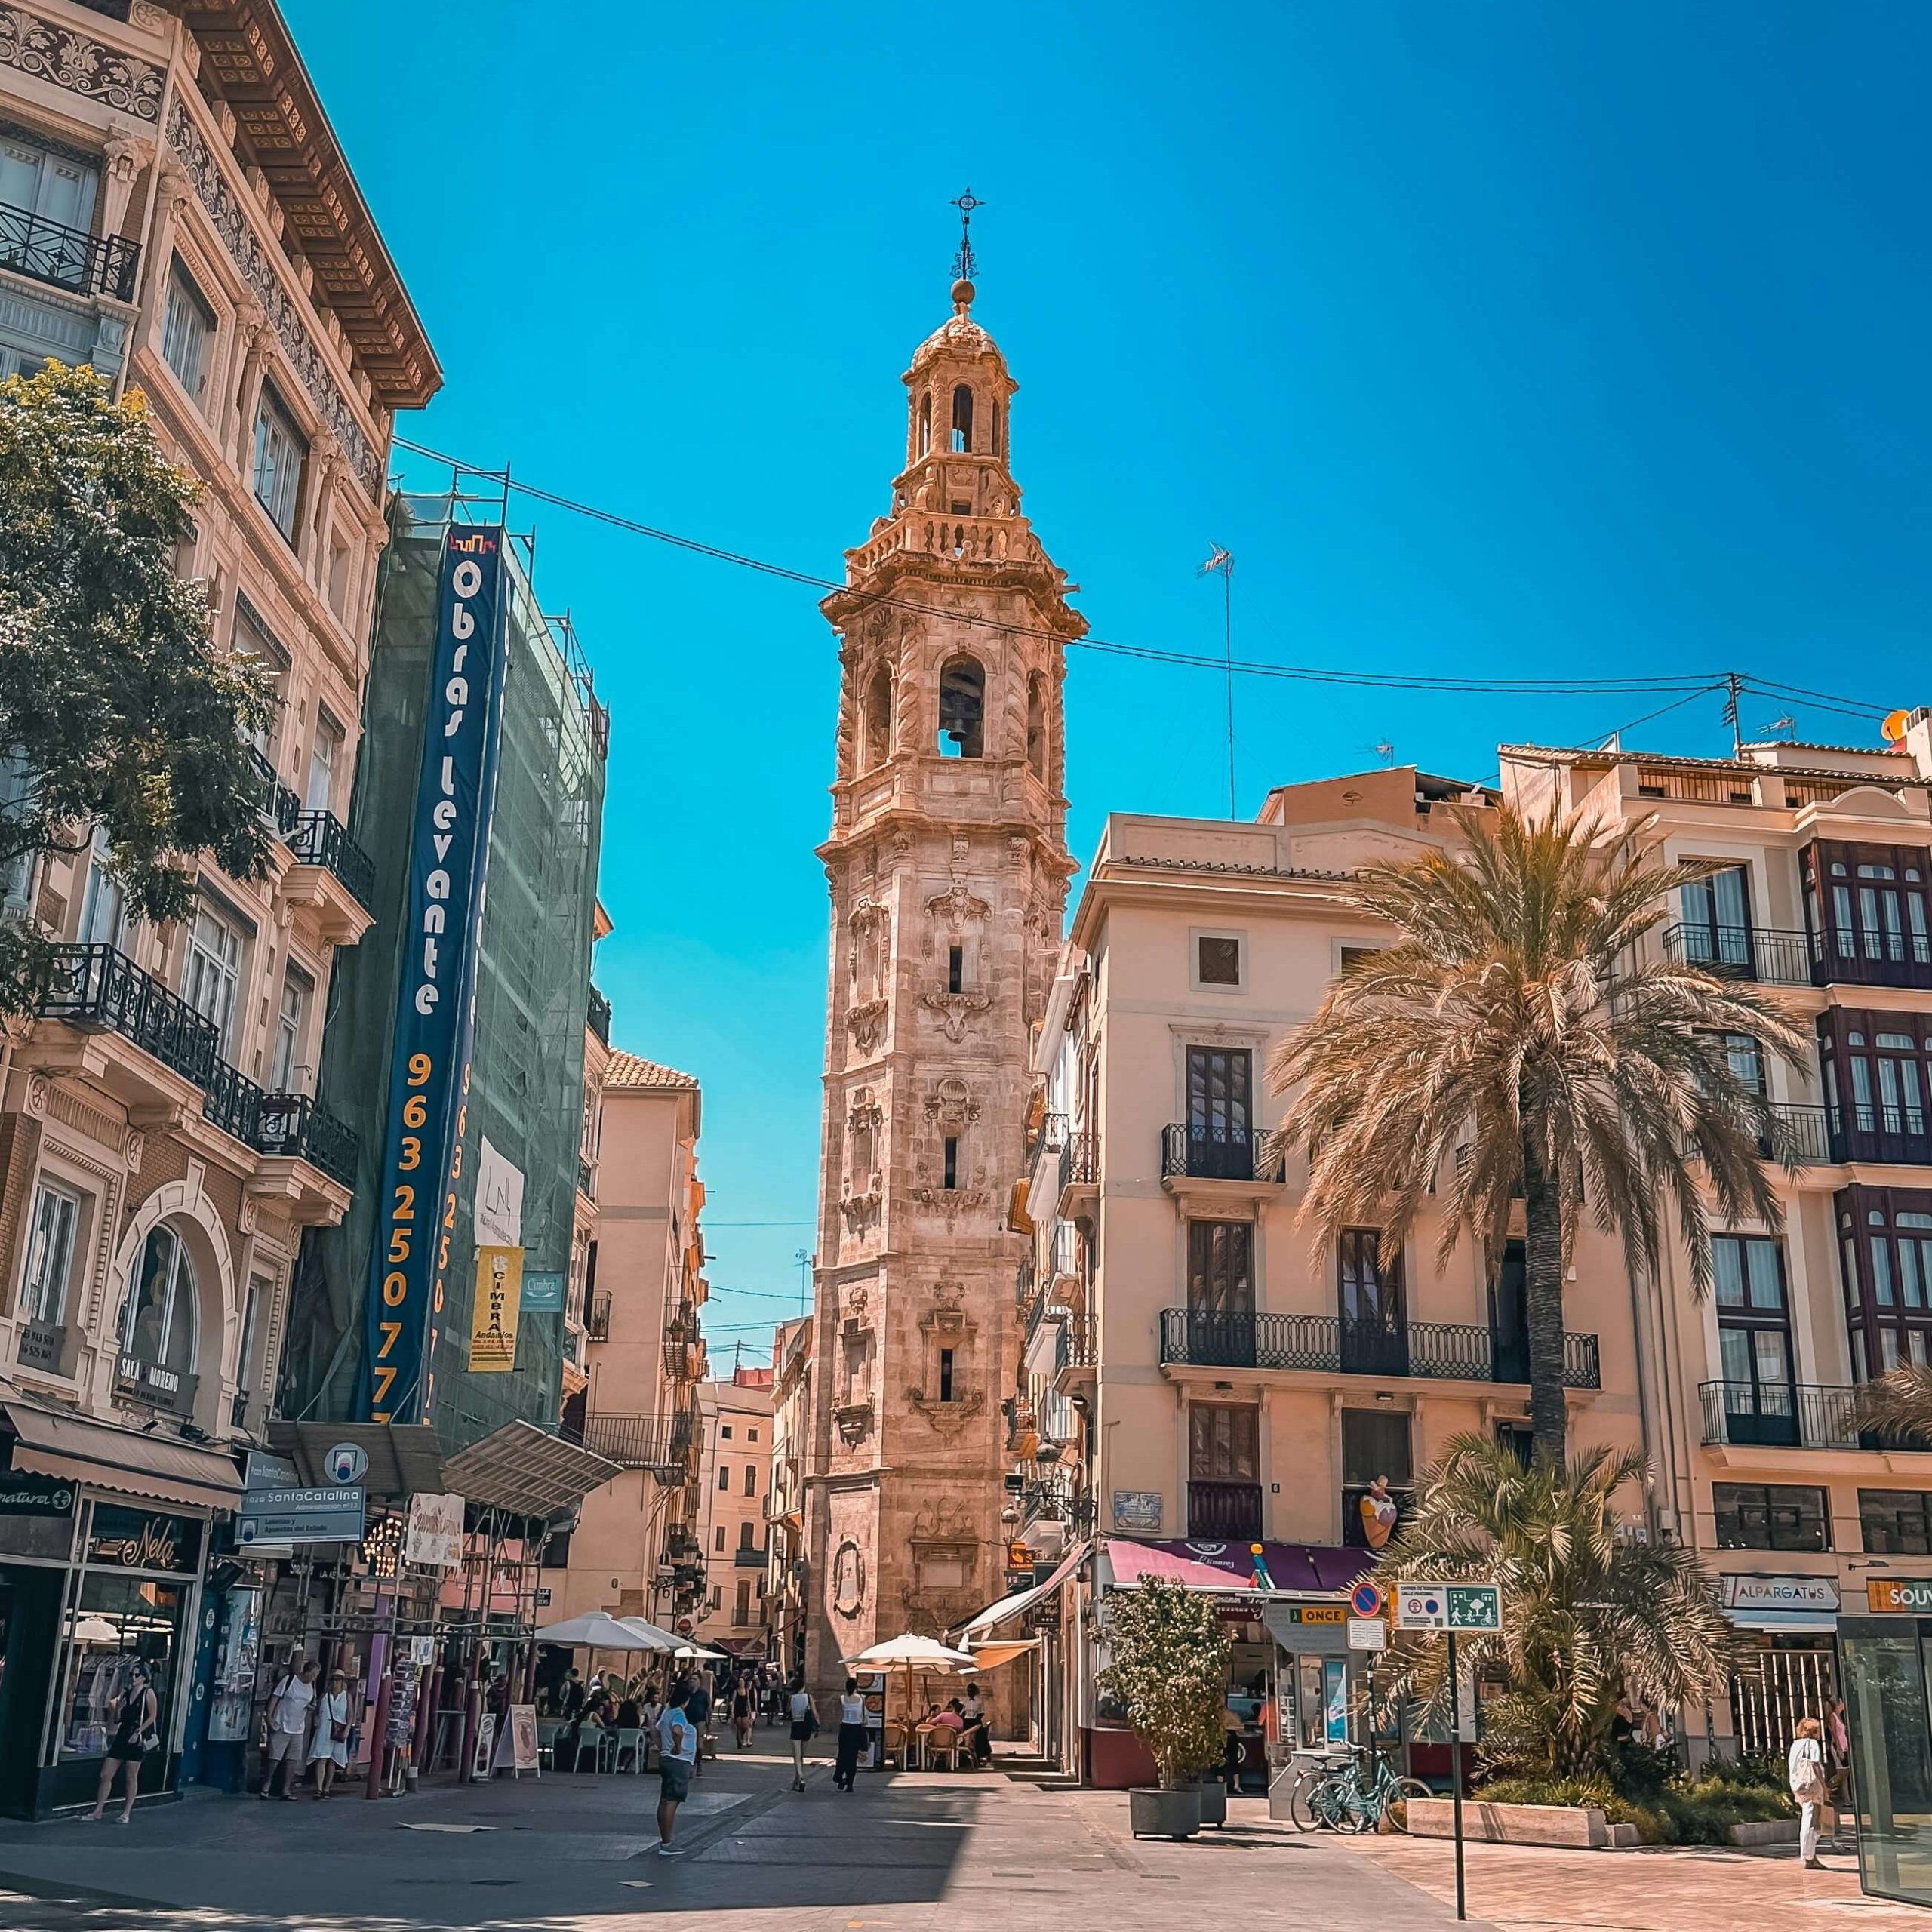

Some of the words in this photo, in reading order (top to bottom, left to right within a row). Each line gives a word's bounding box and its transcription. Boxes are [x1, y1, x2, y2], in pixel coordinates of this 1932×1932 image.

[444, 559, 481, 737] Obras
[415, 755, 457, 1015] levante
[398, 1053, 432, 1171] 963
[383, 1185, 415, 1307] 250
[488, 1271, 506, 1331] CIMBRA
[475, 1331, 513, 1339] Andamios
[149, 1367, 179, 1392] MORENO
[423, 1328, 438, 1426] 77
[267, 1491, 359, 1503] SantaCatalina
[122, 1517, 174, 1566] Nela
[1306, 1611, 1341, 1620] ONCE
